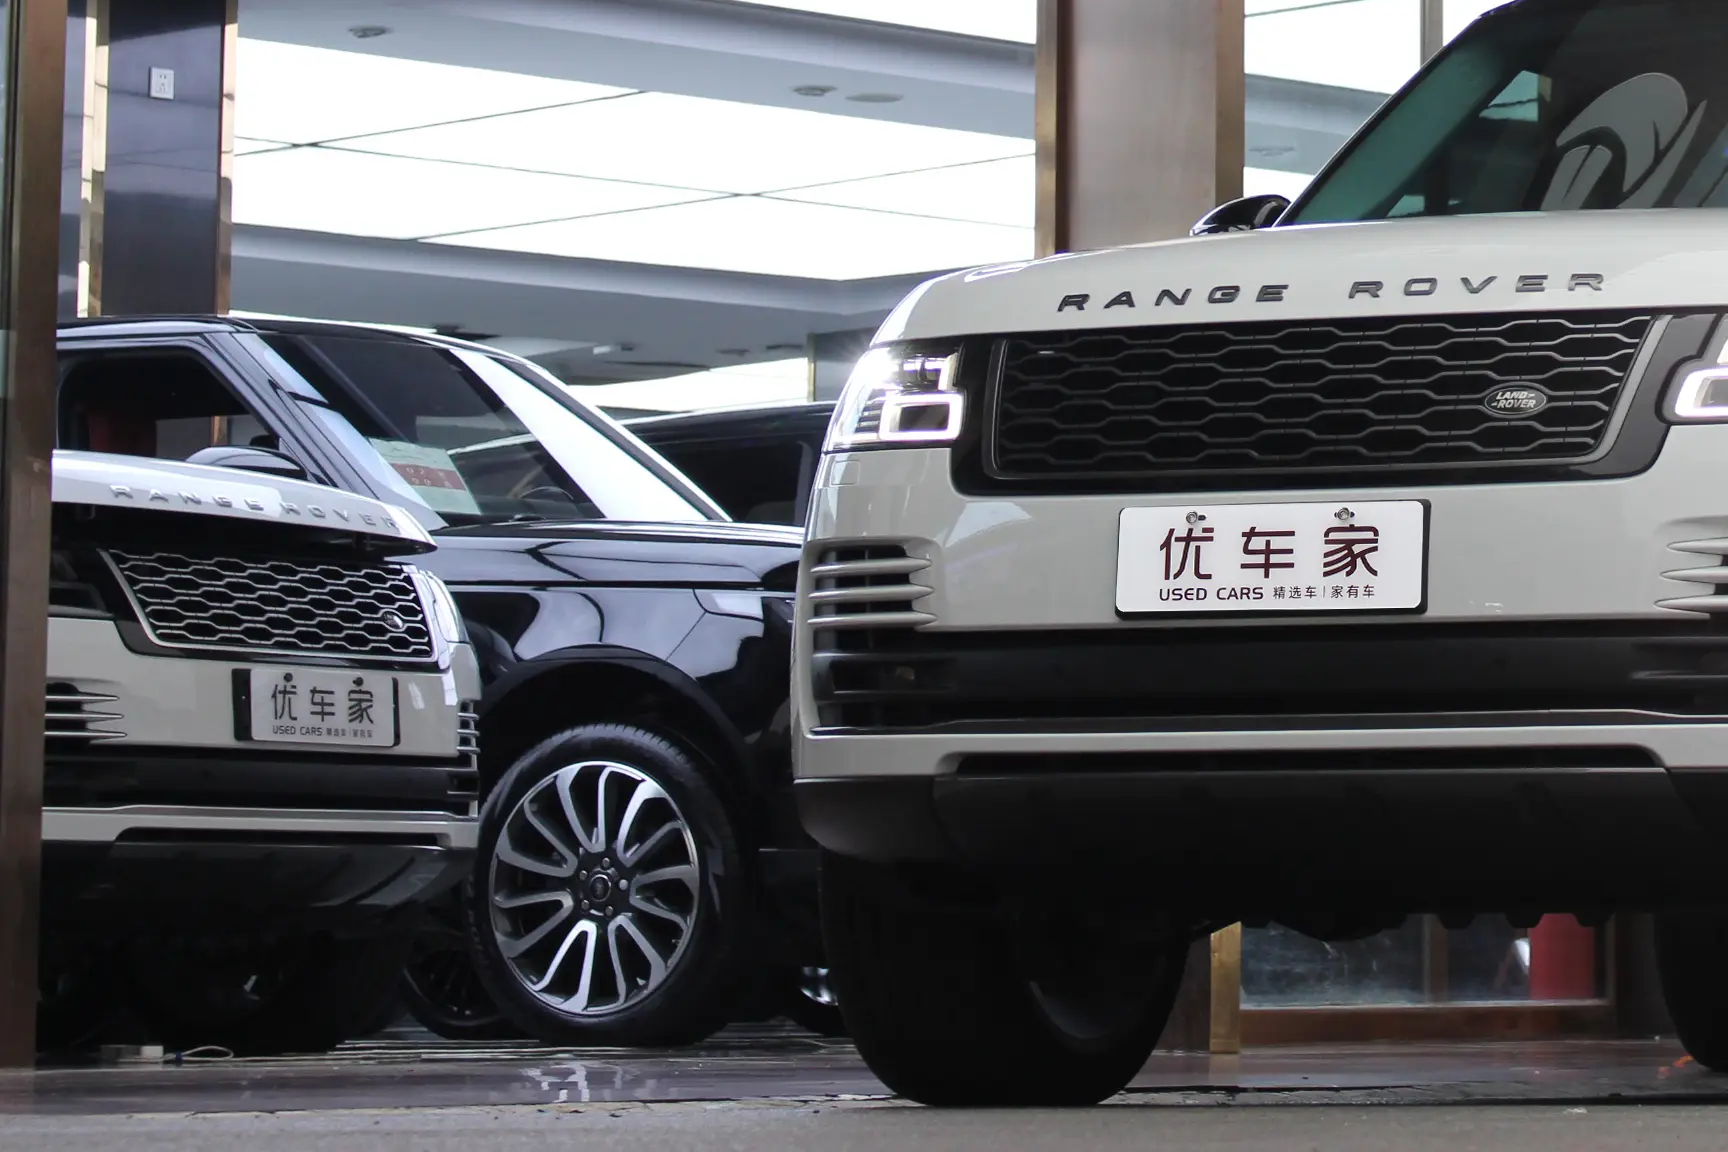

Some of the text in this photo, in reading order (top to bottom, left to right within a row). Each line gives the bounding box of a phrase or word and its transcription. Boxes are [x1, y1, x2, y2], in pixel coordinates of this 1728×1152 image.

[1057, 273, 1604, 312] RANGE ROVER
[1496, 391, 1529, 400] LAND
[1497, 399, 1537, 409] ROVER
[109, 484, 400, 531] RANGE ROVER
[1159, 523, 1380, 581] 优车家
[1159, 586, 1264, 601] USED CARS
[271, 683, 374, 724] 优车家
[272, 725, 297, 735] USED
[299, 726, 323, 737] CARS
